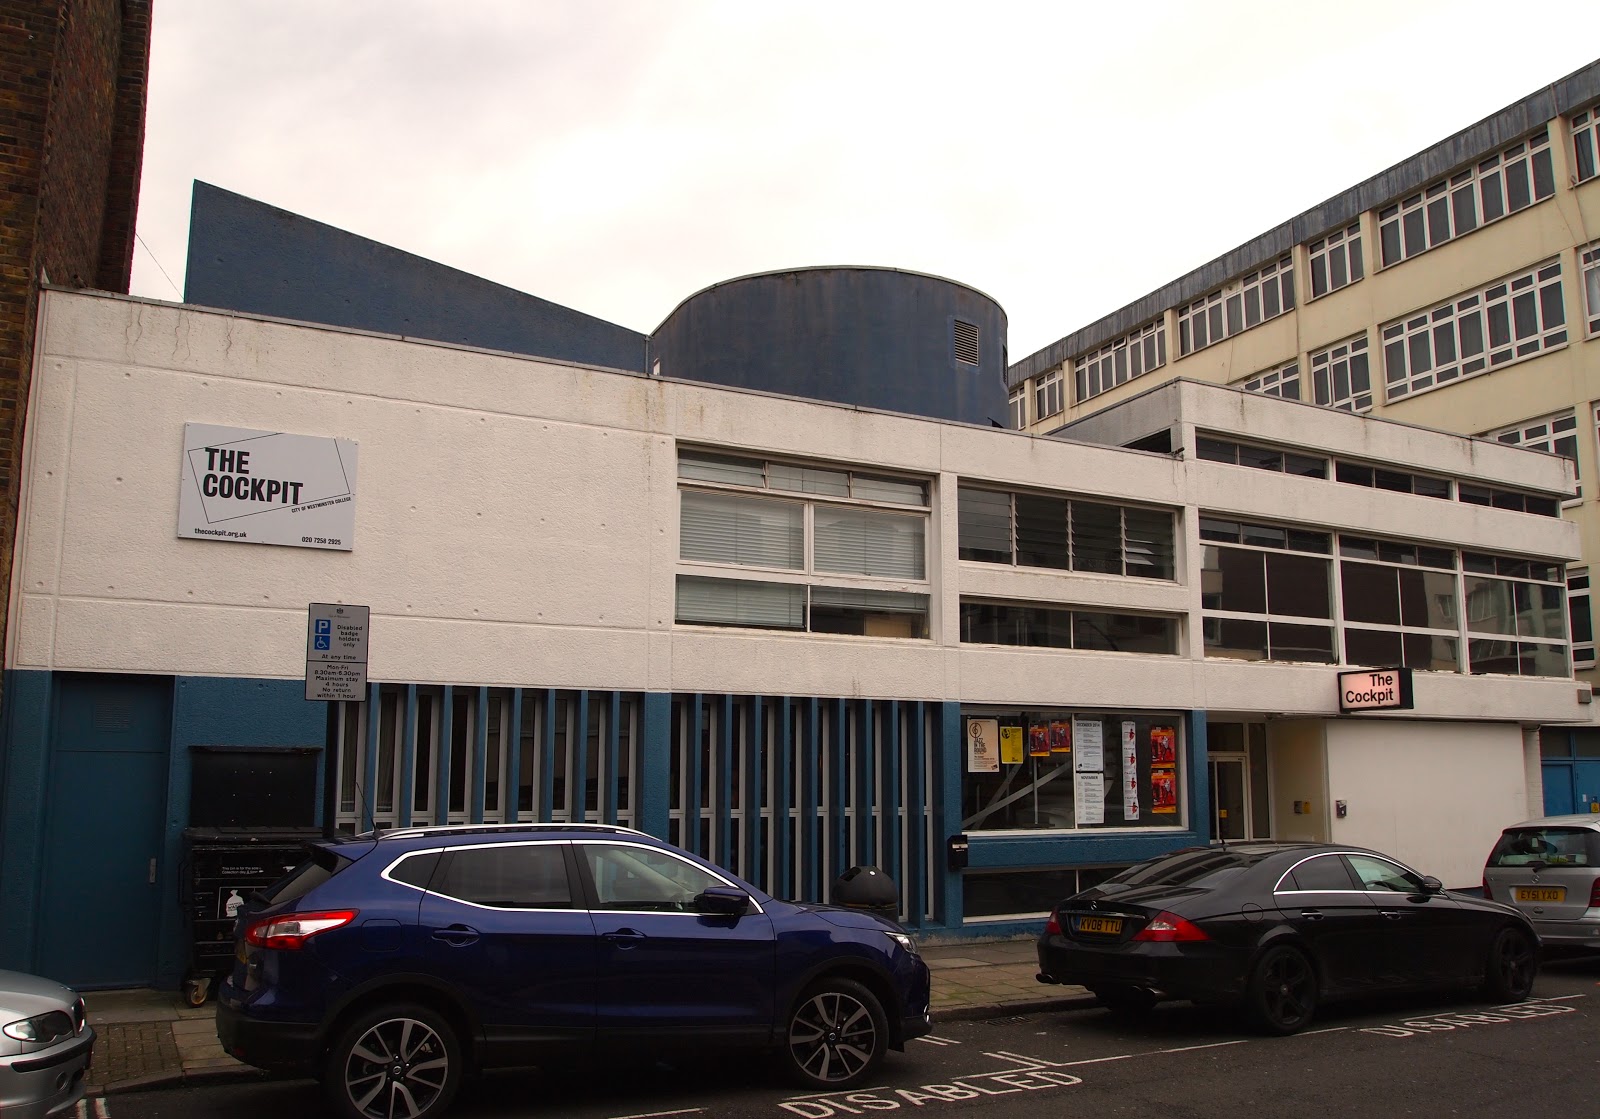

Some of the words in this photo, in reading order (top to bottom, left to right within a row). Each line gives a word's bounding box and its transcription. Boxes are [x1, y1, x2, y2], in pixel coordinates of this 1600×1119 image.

[205, 447, 250, 474] THE
[203, 473, 303, 505] COCKPIT
[307, 500, 335, 510] WESTMINSTER
[335, 496, 352, 504] COLLEGE
[194, 527, 247, 538] thecockpit.org.uk
[1369, 673, 1393, 687] The
[1345, 688, 1394, 704] Cockpit
[1080, 918, 1103, 931] KV08
[1104, 920, 1121, 932] TTU
[777, 1071, 1083, 1119] DISABLED
